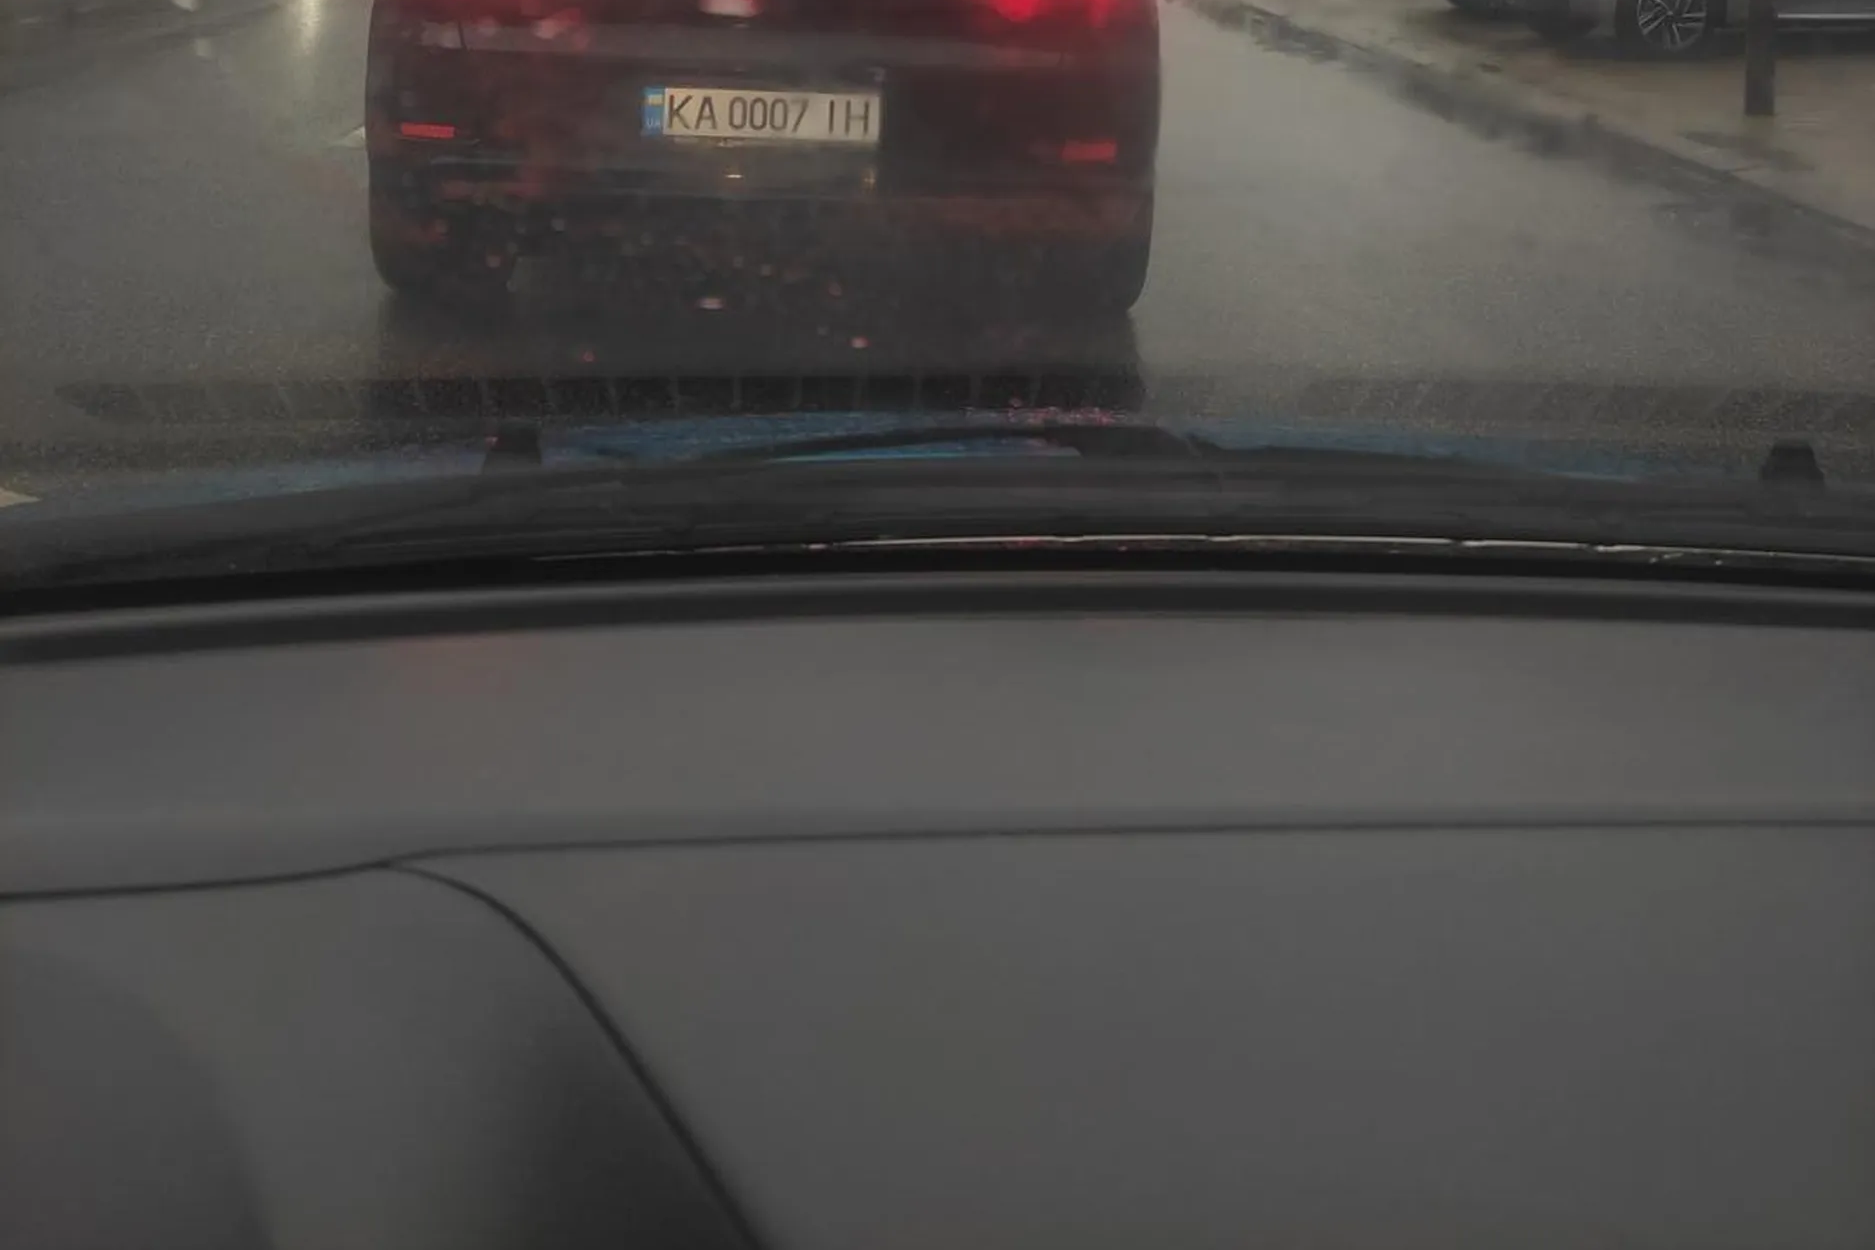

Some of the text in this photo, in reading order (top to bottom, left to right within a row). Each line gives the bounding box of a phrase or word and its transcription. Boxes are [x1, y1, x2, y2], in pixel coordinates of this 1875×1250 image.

[667, 94, 870, 137] KA 0007 IH
